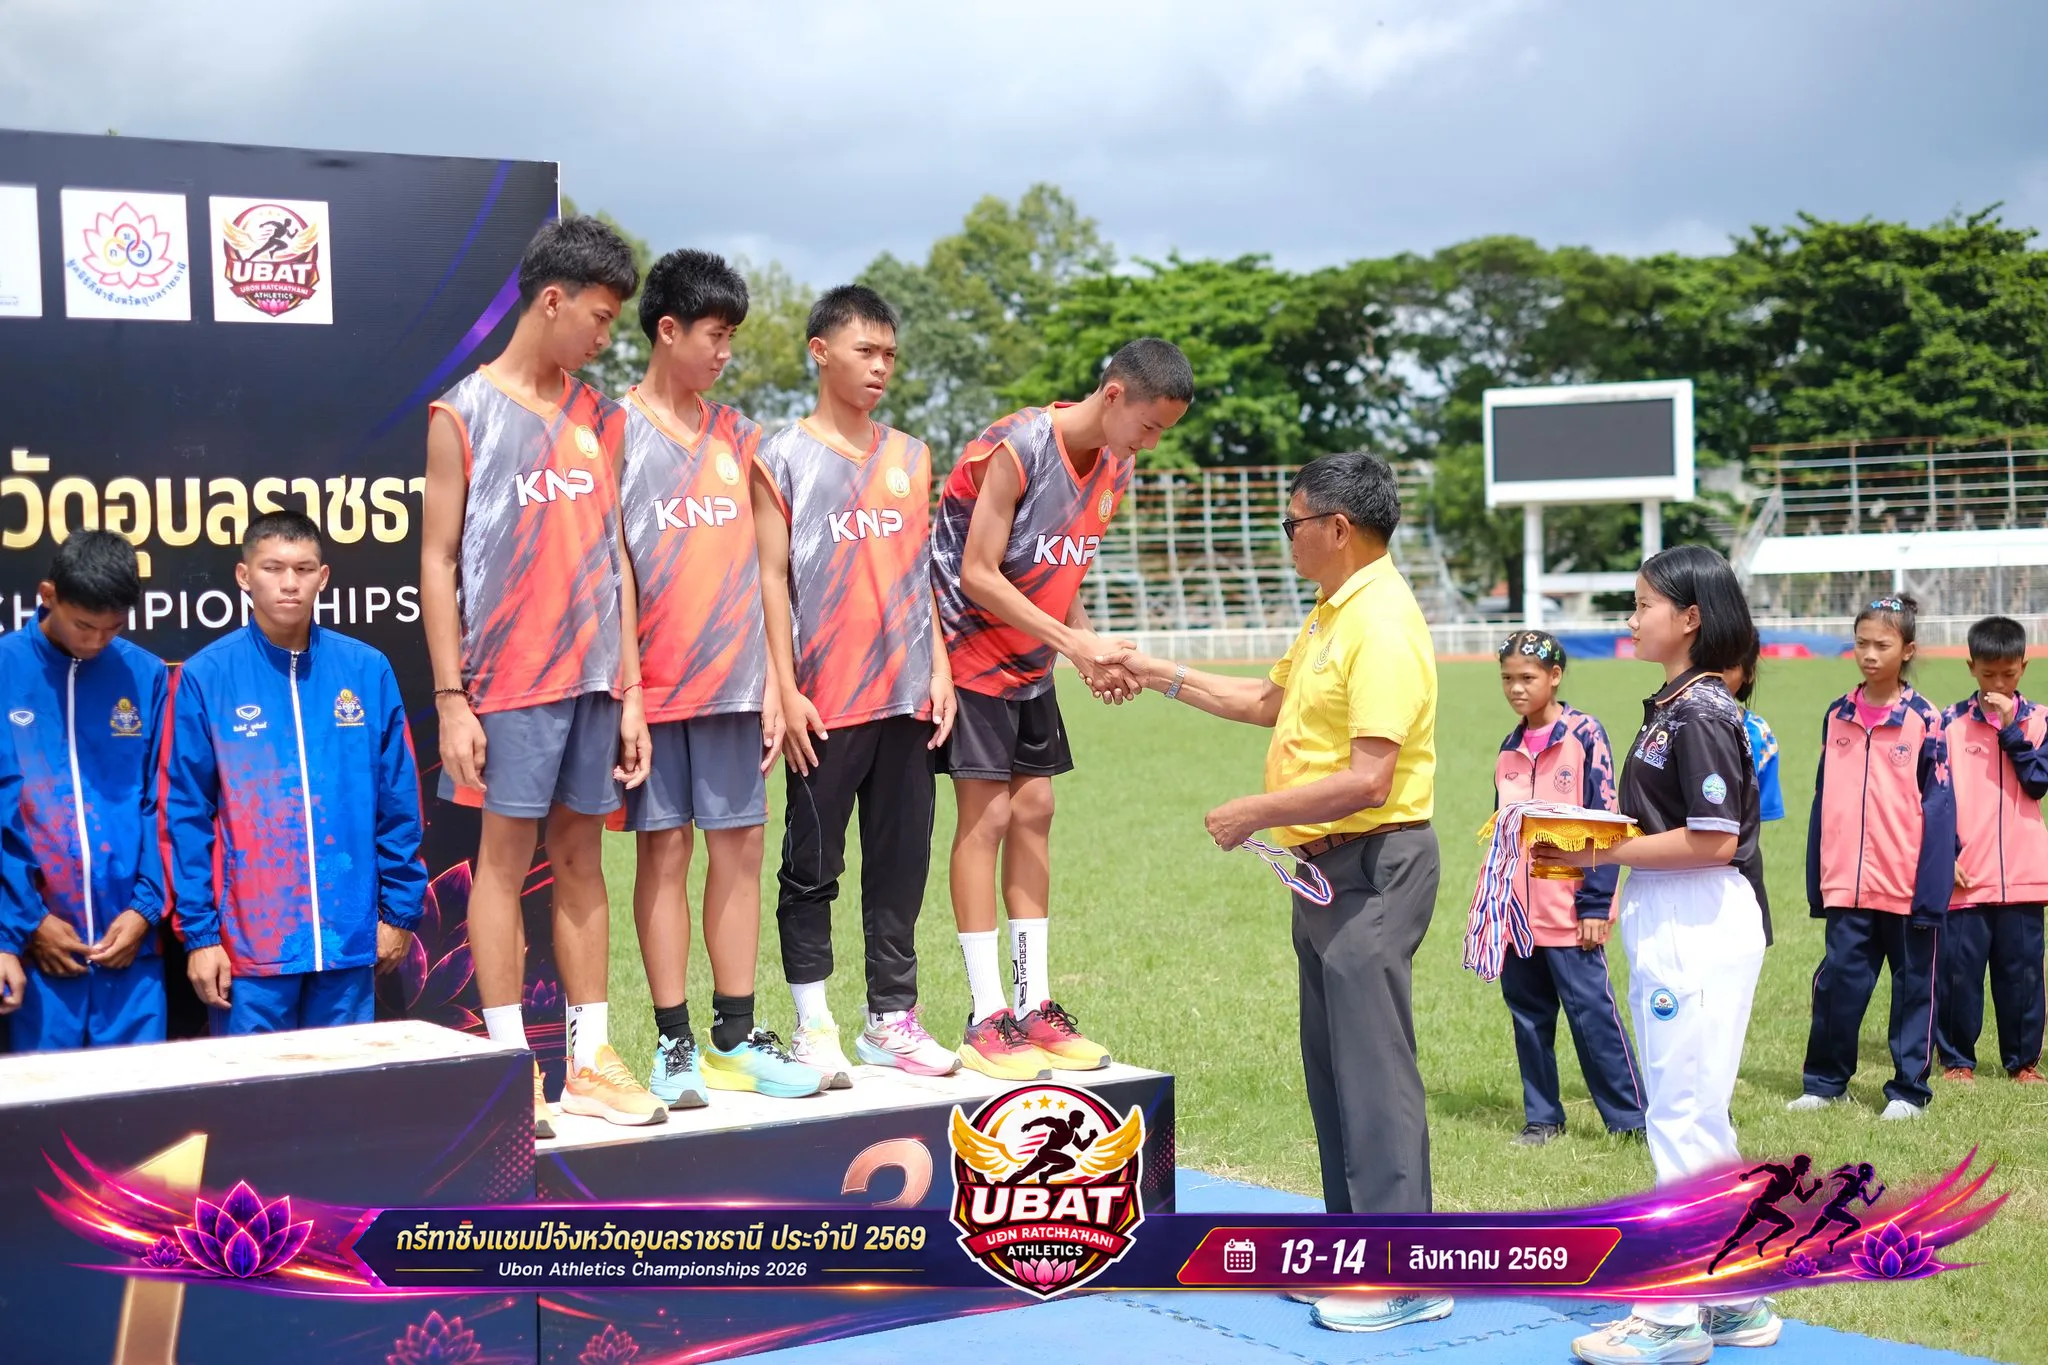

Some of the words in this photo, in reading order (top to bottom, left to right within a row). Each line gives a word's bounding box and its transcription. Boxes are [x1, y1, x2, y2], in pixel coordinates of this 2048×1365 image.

[231, 261, 313, 285] UBAT
[254, 292, 294, 300] ATHLETICS
[514, 468, 595, 507] KNP
[653, 495, 738, 531] KNP
[827, 508, 904, 543] KNP
[1032, 534, 1100, 566] KNP
[1018, 931, 1027, 982] TAPEDESIGN
